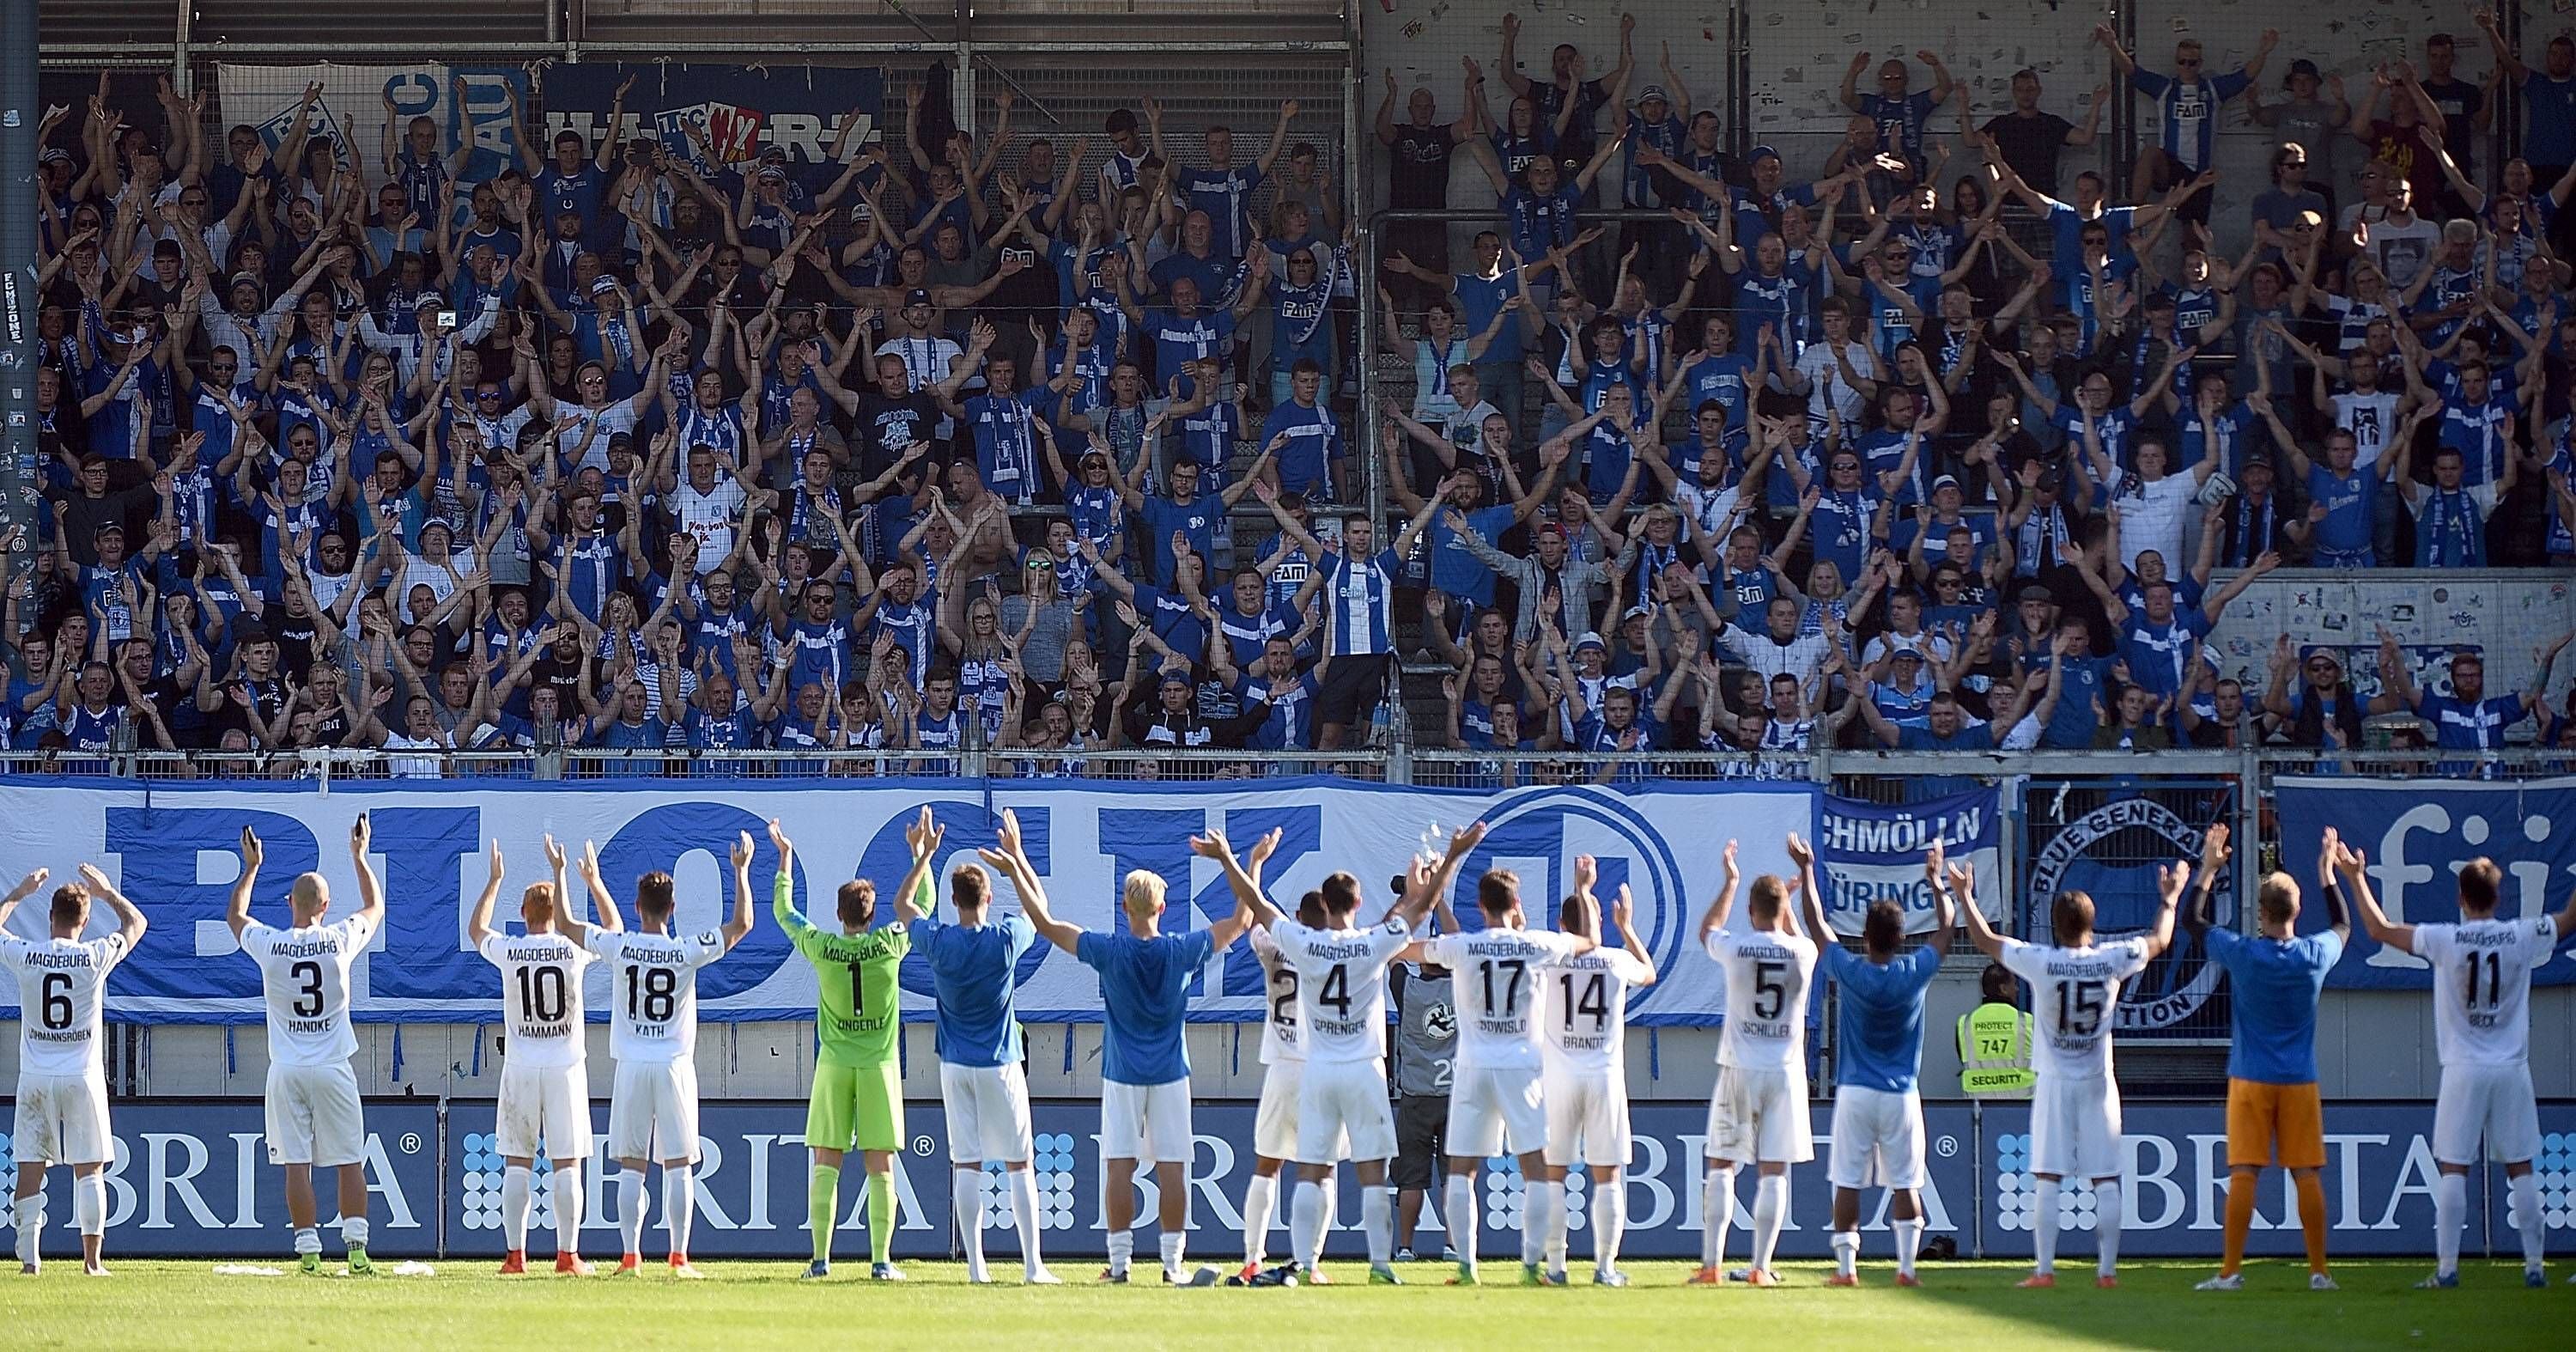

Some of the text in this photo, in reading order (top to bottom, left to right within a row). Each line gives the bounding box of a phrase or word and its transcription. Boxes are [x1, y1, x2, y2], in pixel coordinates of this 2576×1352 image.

[1274, 566, 1306, 581] FAM
[2034, 830, 2085, 893] BLUE
[105, 801, 1321, 1000] BLOCK
[26, 950, 91, 969] MAGDEBURG
[271, 940, 337, 959] MAGDEBURG
[507, 946, 574, 963] MAGDEBURG
[621, 945, 685, 964] MAGDEBURG
[823, 942, 889, 964] MAGDEBURG
[1468, 941, 1536, 958] MAGDEBURG
[291, 960, 324, 1018] 3
[515, 965, 566, 1022] 10
[625, 965, 677, 1021] 18
[848, 962, 863, 1017] 1
[1319, 965, 1352, 1020] 4
[1479, 959, 1527, 1018] 17
[1754, 962, 1787, 1020] 5
[2466, 951, 2500, 1009] 11
[41, 972, 74, 1029] 6
[1273, 968, 1298, 1026] 2
[1560, 973, 1609, 1032] 14
[2057, 980, 2105, 1034] 15
[2118, 994, 2192, 1026] TION
[518, 1023, 573, 1038] HAMMANN
[635, 1024, 665, 1038] KATH
[1975, 1020, 2014, 1032] PROTECT
[2468, 1013, 2496, 1028] BECK
[1563, 1035, 1607, 1050] BRANDT
[1982, 1038, 2008, 1055] 747
[1971, 1072, 2022, 1087] SECURITY
